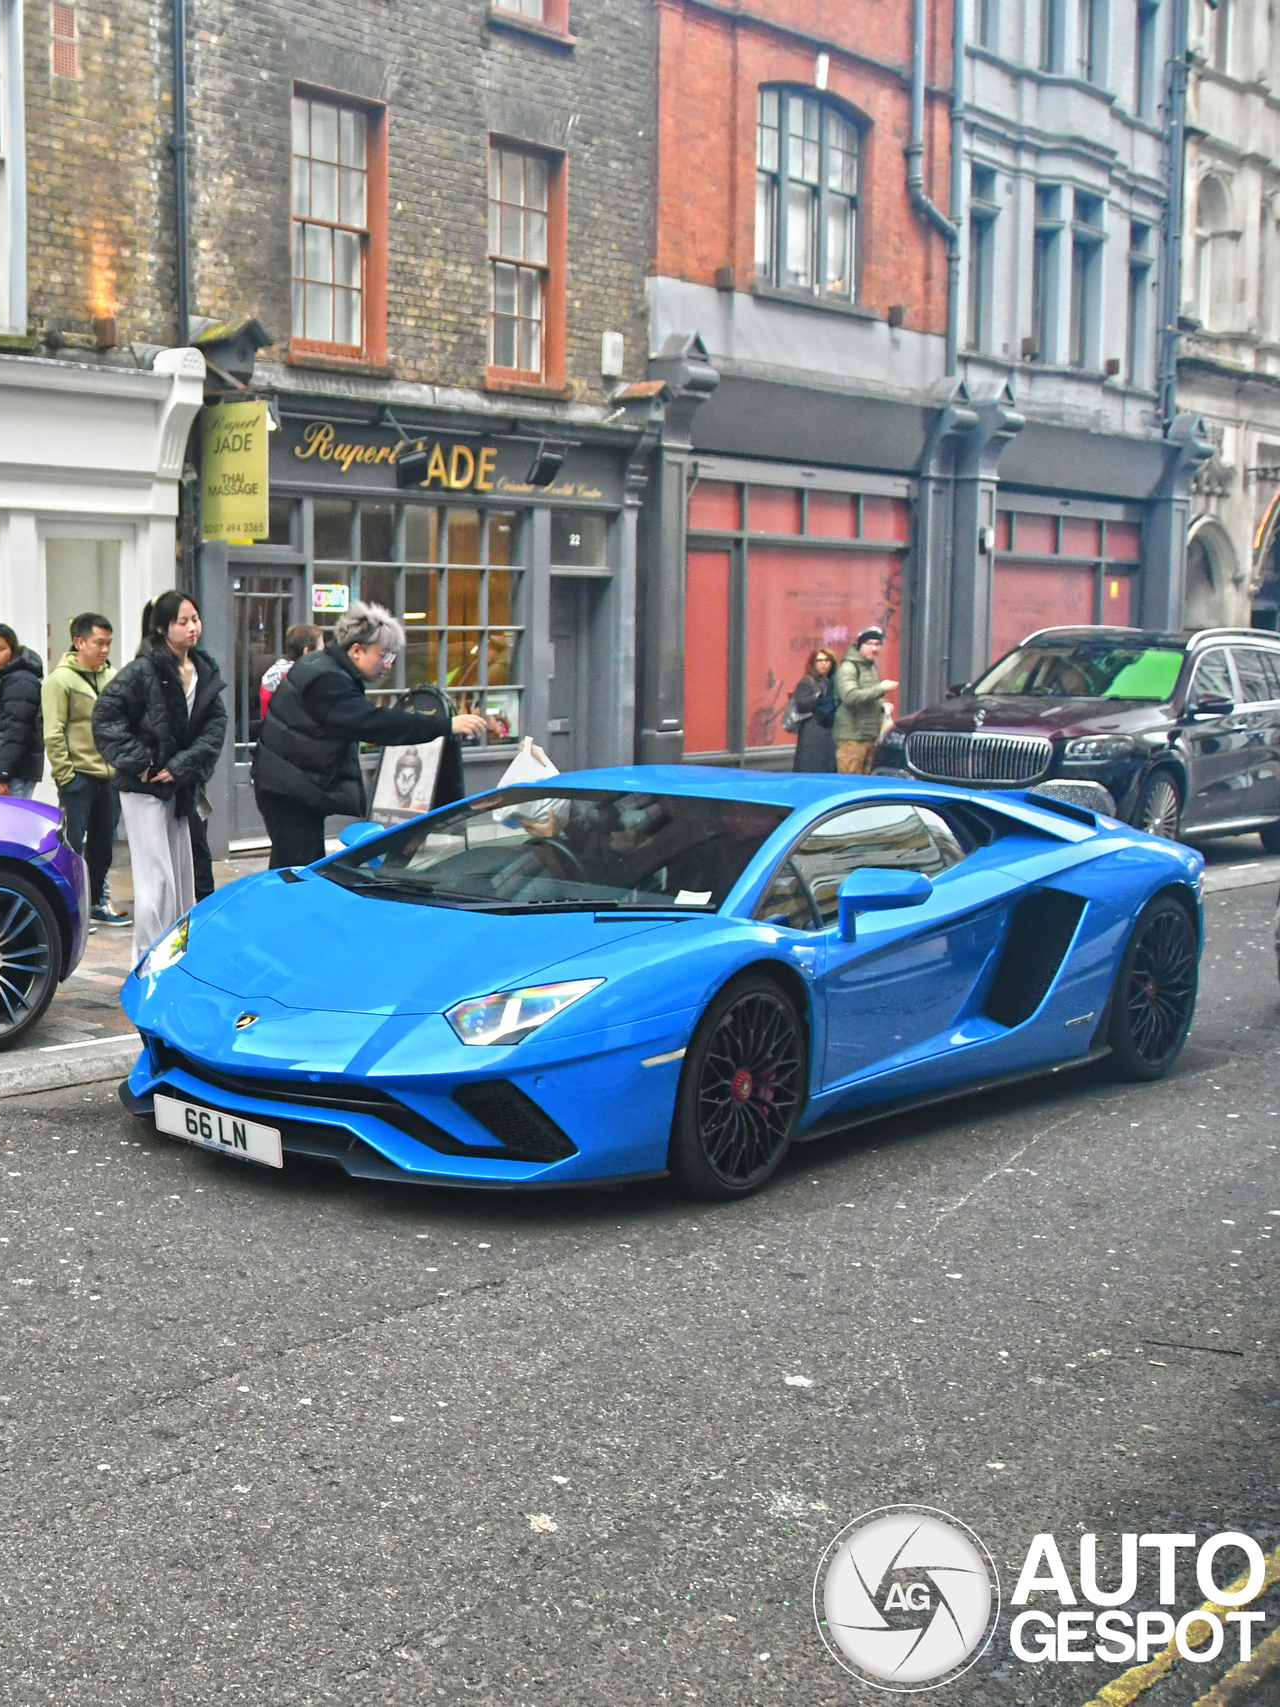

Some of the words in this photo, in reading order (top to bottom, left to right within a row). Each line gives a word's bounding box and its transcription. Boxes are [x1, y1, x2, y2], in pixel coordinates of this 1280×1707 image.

[212, 415, 261, 434] Rupert
[215, 433, 253, 453] JADE
[222, 472, 245, 485] THAI
[208, 483, 258, 496] MASSAGE
[569, 533, 581, 547] 22
[372, 812, 390, 823] Thai
[185, 1107, 212, 1139] 66
[218, 1116, 247, 1151] LN
